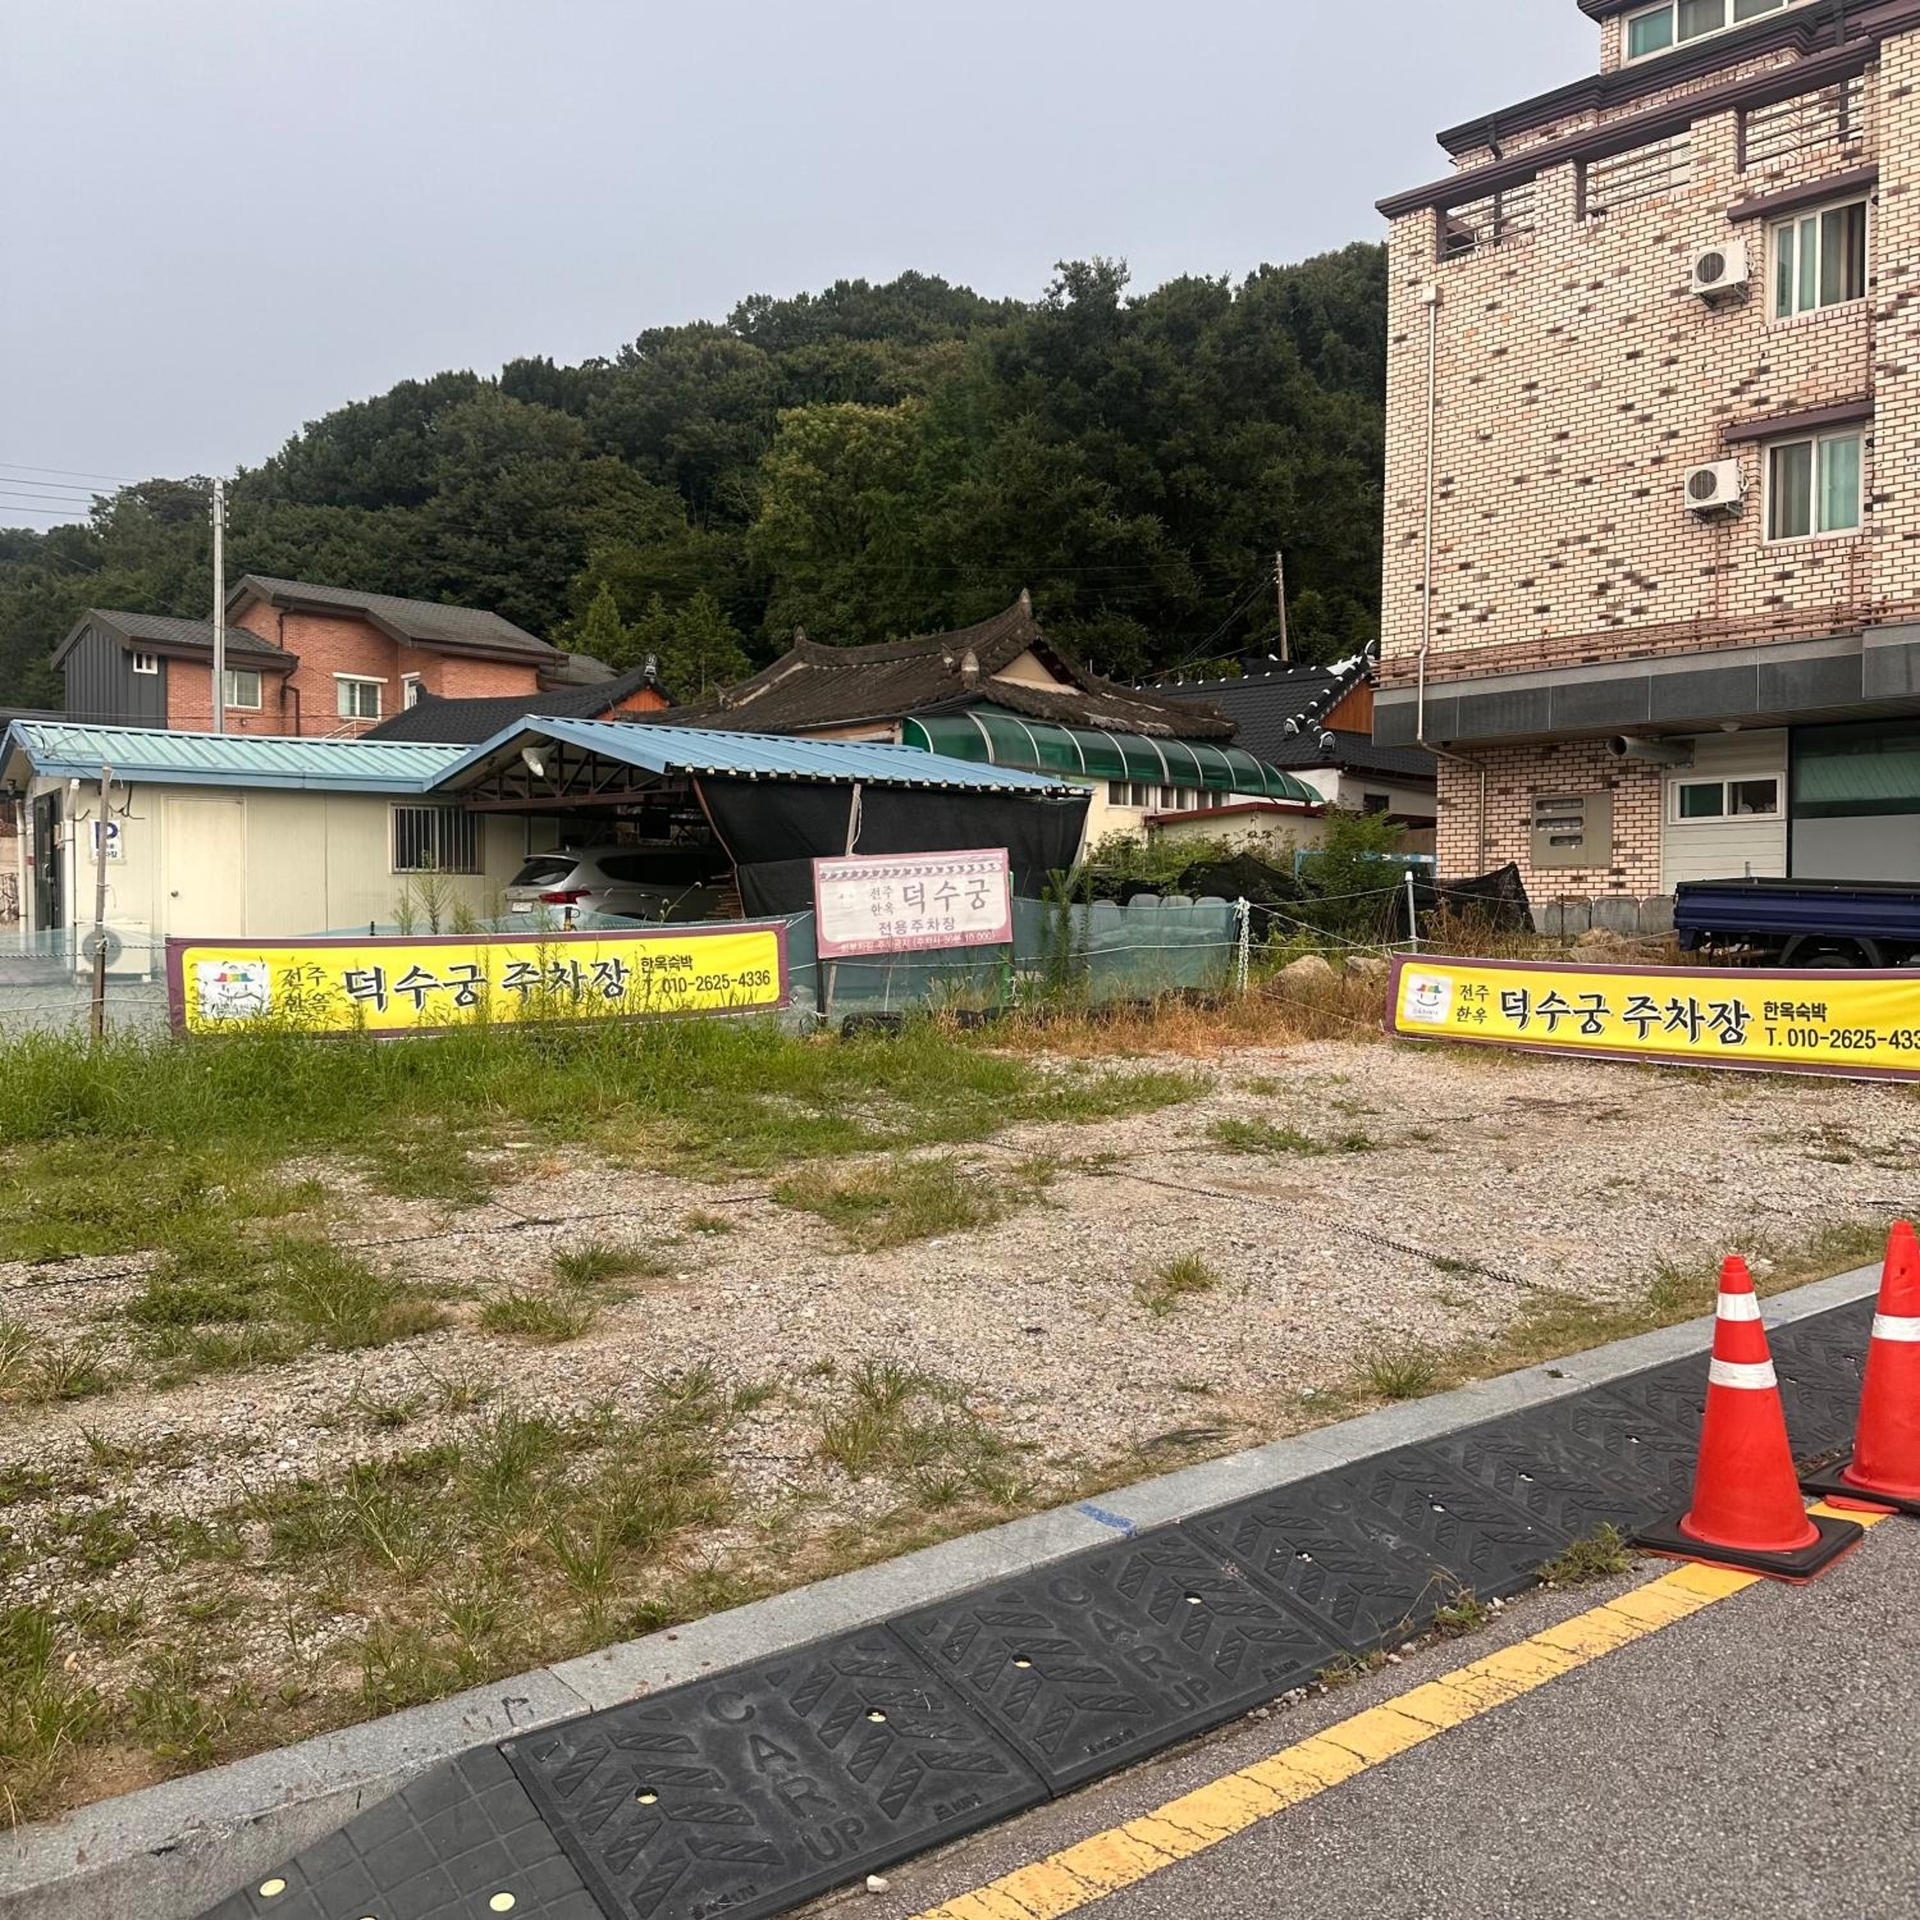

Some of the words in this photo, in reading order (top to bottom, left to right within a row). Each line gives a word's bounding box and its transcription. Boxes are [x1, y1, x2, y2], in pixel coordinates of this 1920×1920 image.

[902, 879, 991, 914] 덕수궁
[879, 917, 956, 937] 전용주차장
[640, 954, 693, 974] 한옥숙박
[344, 964, 489, 1011] 덕수궁
[502, 957, 630, 1002] 주차장
[661, 969, 771, 994] 010-2625-4336
[1459, 982, 1490, 1002] 전주
[1456, 1006, 1488, 1025] 한옥
[1500, 987, 1612, 1036] 덕수궁
[1622, 995, 1752, 1046] 주차장
[1763, 1001, 1828, 1022] 한옥숙박
[706, 1691, 838, 1819] CAR
[801, 1817, 865, 1861] UP
